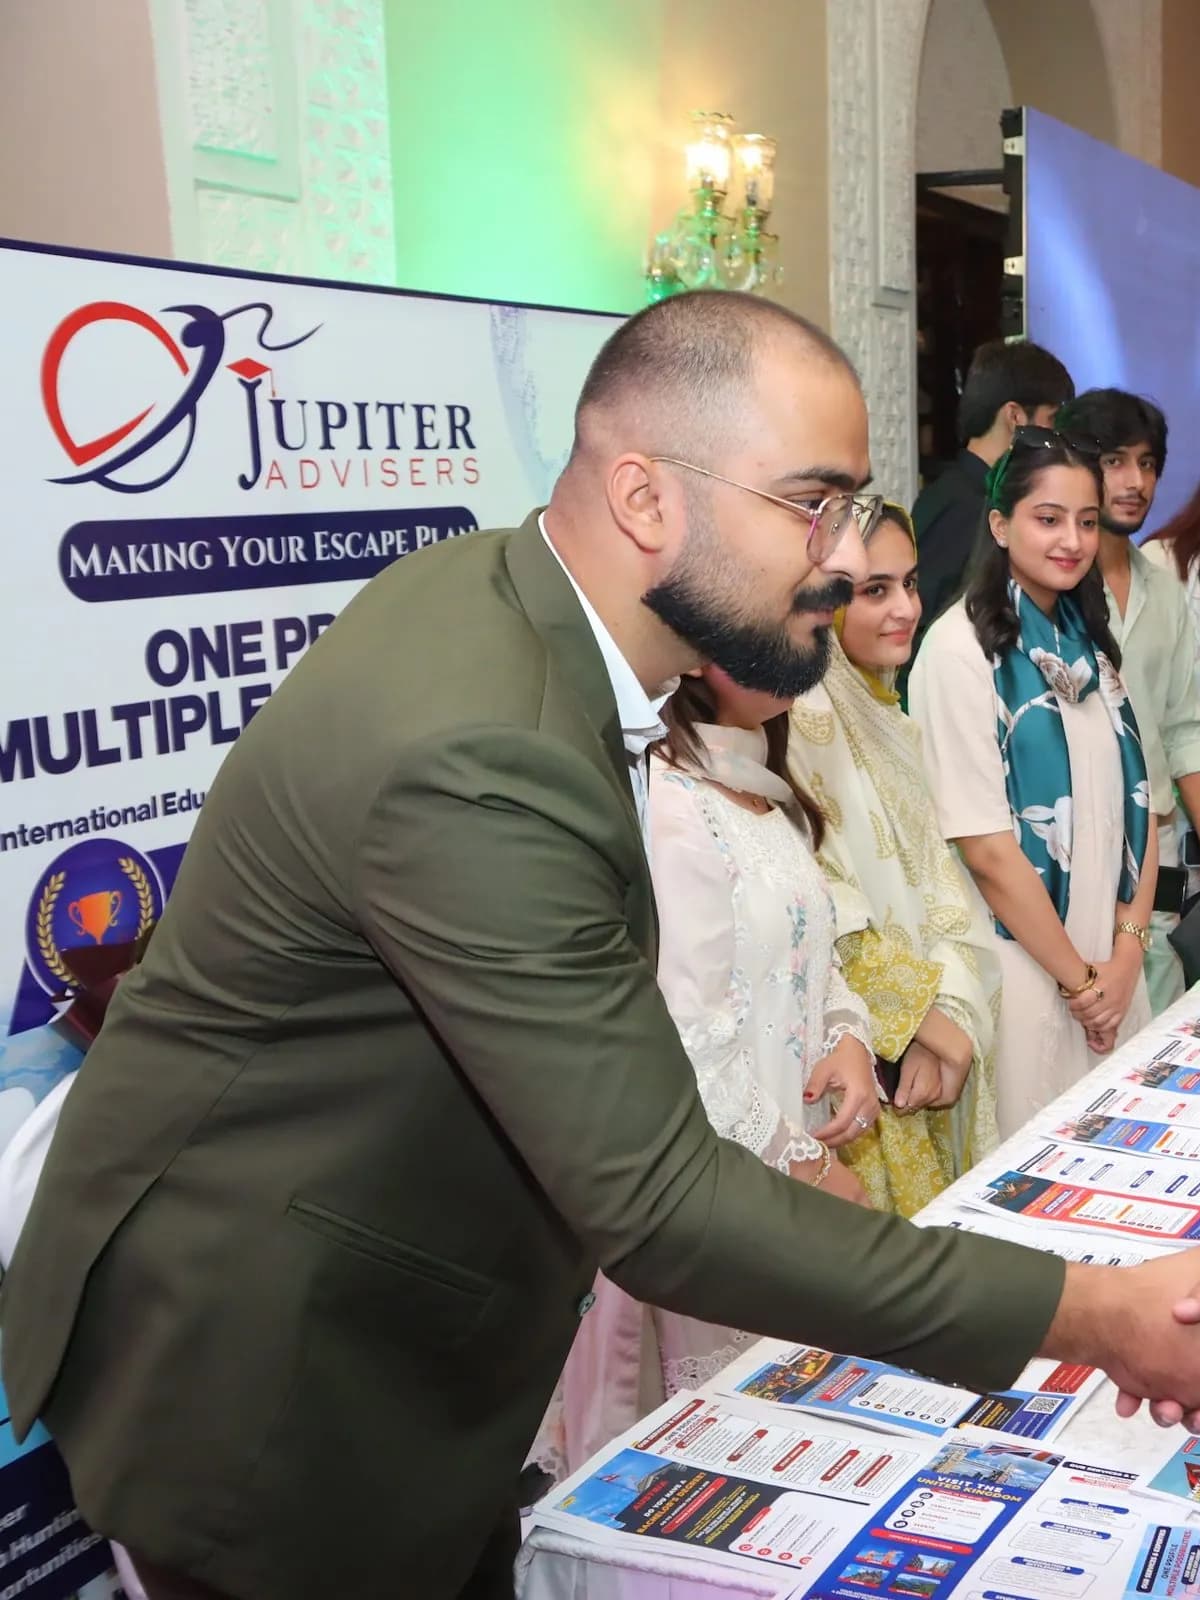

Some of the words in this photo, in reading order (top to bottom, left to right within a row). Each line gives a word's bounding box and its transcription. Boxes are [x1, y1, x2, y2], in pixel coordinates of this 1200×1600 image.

[238, 378, 477, 490] JUPITER
[265, 457, 481, 490] ADVISERS
[145, 620, 266, 688] ONE
[916, 1476, 961, 1492] UNITED
[963, 1486, 1023, 1503] KINGDOM
[937, 1475, 974, 1487] VISIT
[977, 1483, 1004, 1493] THE
